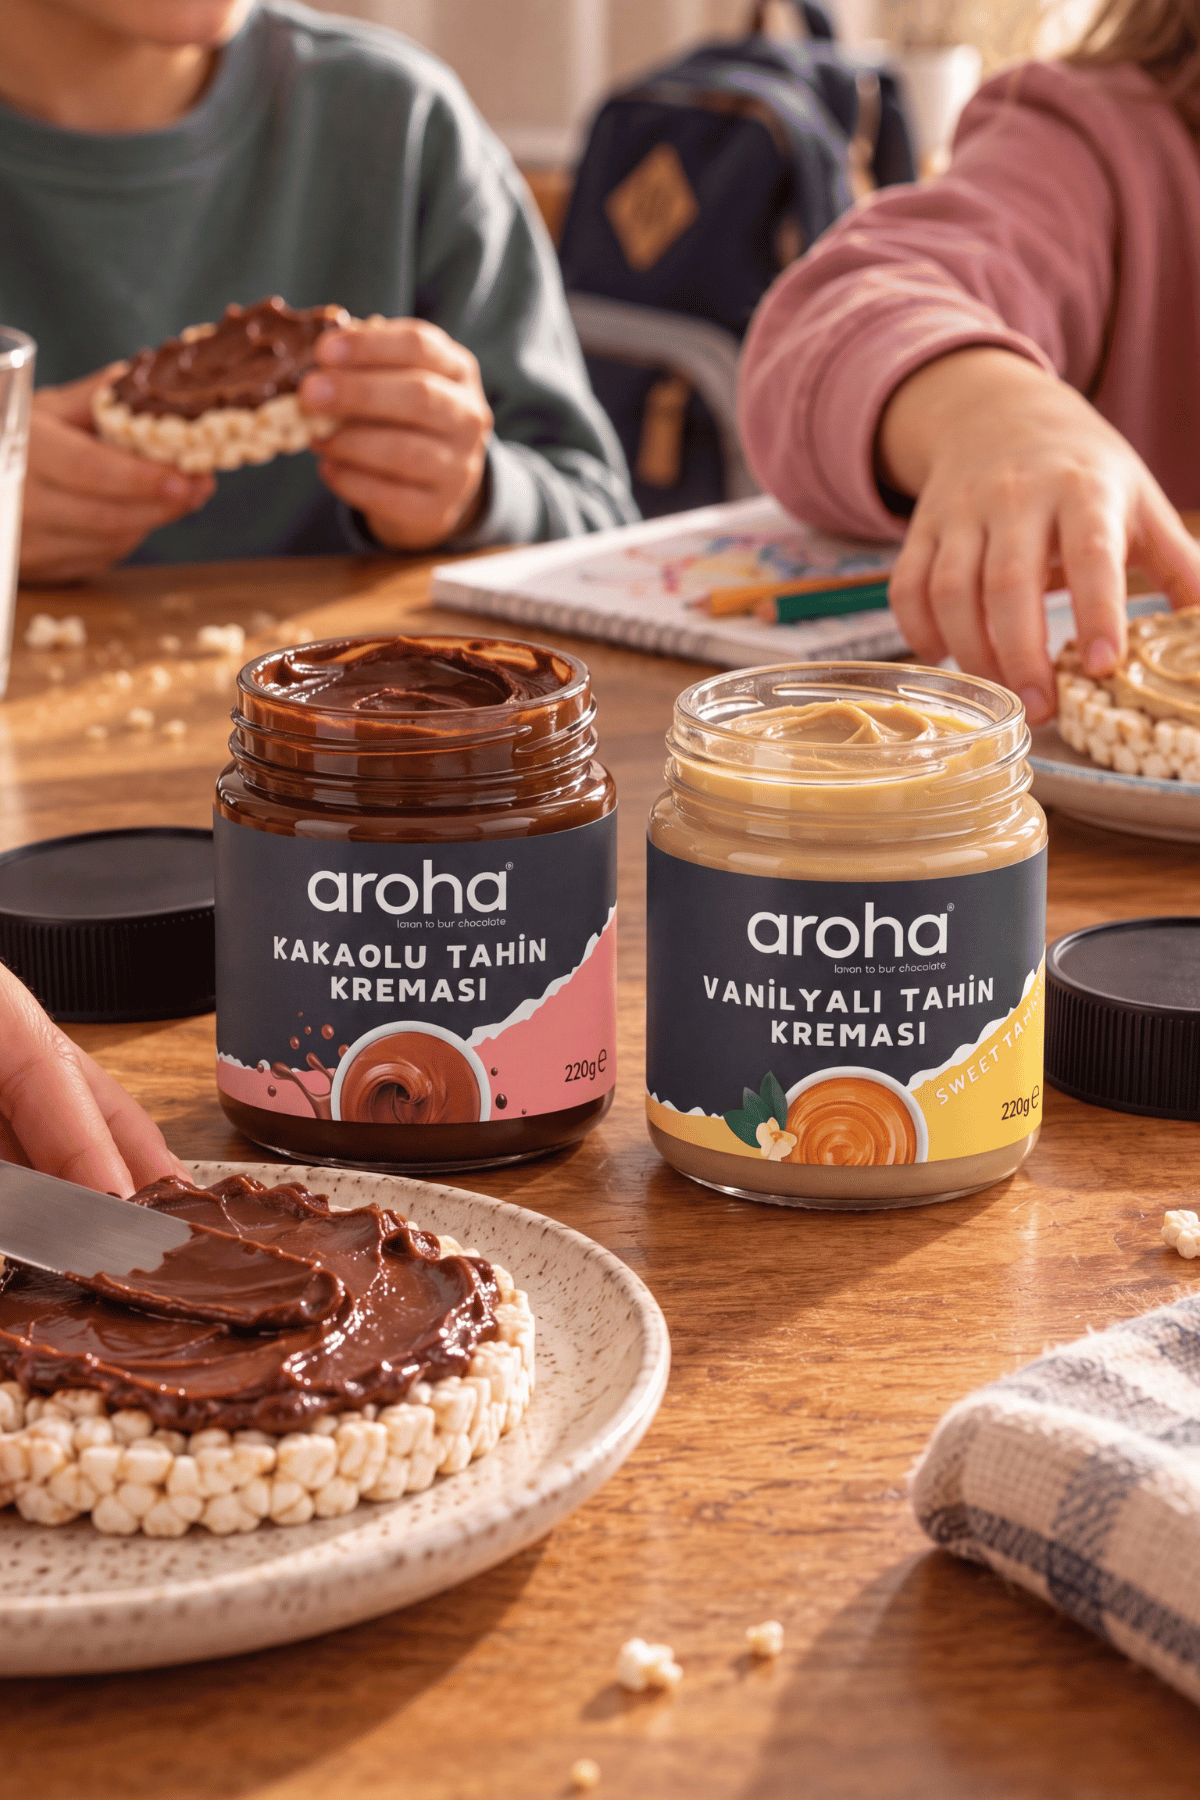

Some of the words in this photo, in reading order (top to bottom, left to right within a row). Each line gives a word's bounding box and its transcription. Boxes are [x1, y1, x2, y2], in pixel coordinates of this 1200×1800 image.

[425, 919, 435, 928] to
[273, 935, 427, 970] KAKAOLU
[865, 964, 876, 974] to
[330, 976, 486, 1003] KREMASI
[771, 1019, 926, 1048] KREMASI
[936, 1045, 999, 1106] SWEET
